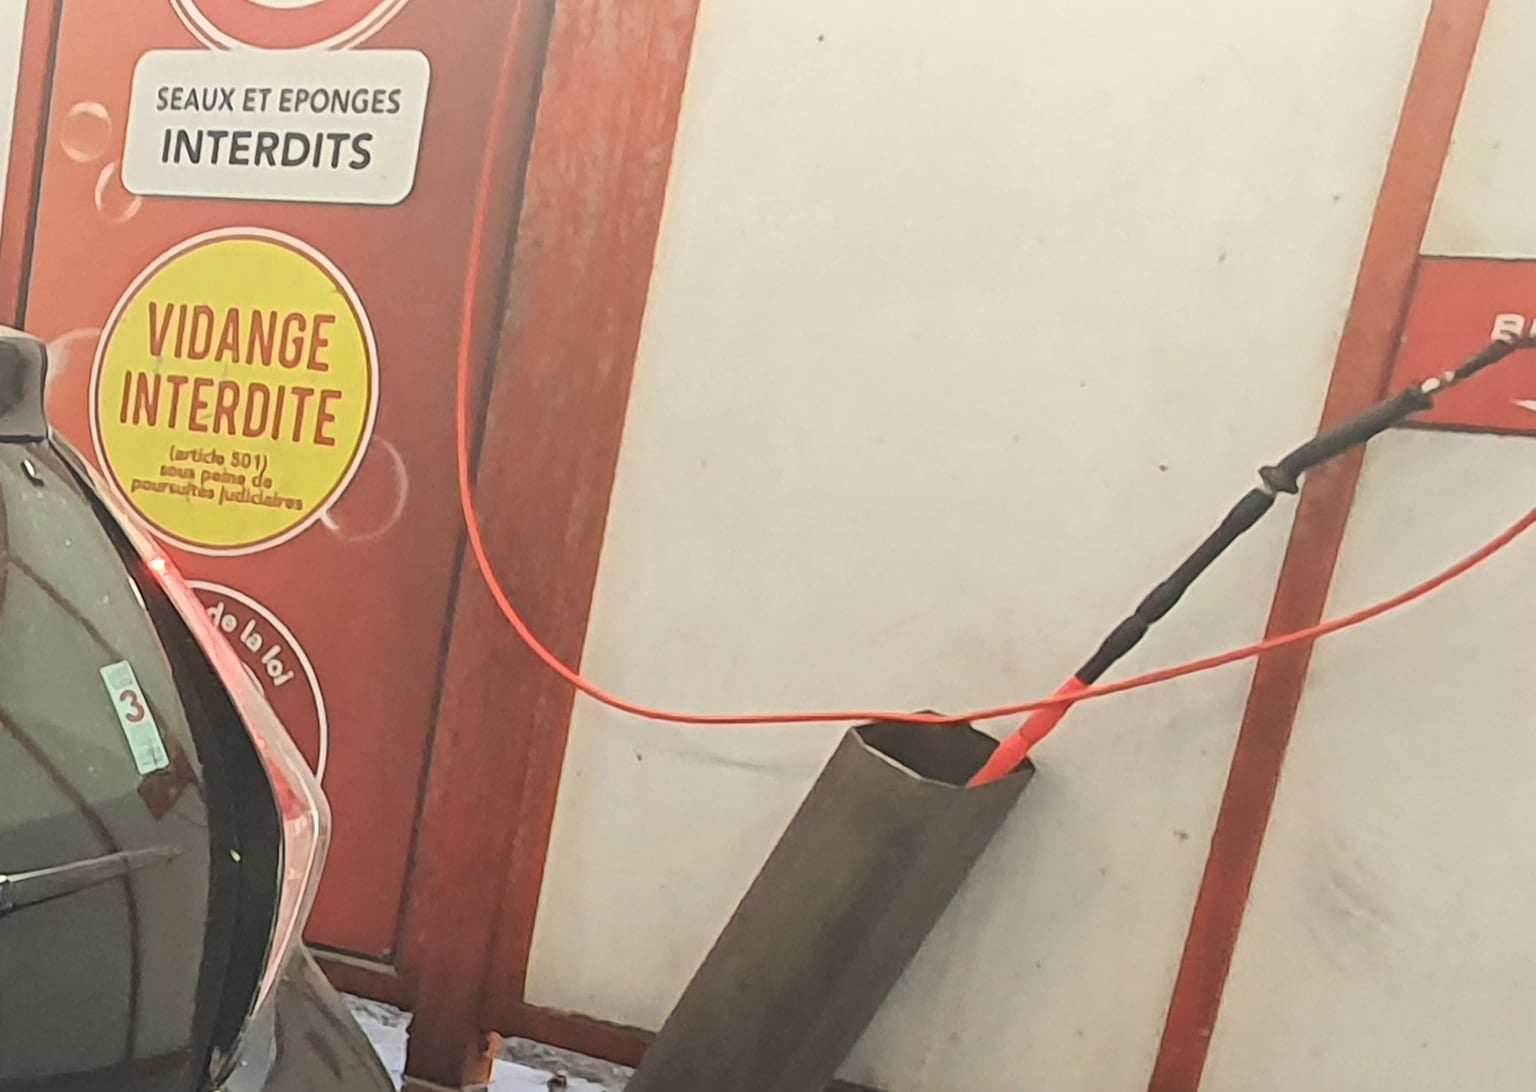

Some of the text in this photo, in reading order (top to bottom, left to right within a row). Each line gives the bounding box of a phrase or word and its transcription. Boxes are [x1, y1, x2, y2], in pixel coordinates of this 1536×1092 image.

[156, 86, 402, 115] SEAUX ET EPONGES
[161, 128, 374, 169] INTERDITS
[147, 301, 336, 371] VIDANGE
[119, 370, 343, 446] INTERDITE
[170, 445, 225, 466] (article
[159, 464, 273, 489] sous peine de
[131, 478, 303, 510] poursuites judiciaires
[240, 619, 263, 652] la
[261, 645, 294, 687] loi
[119, 689, 145, 723] 3
